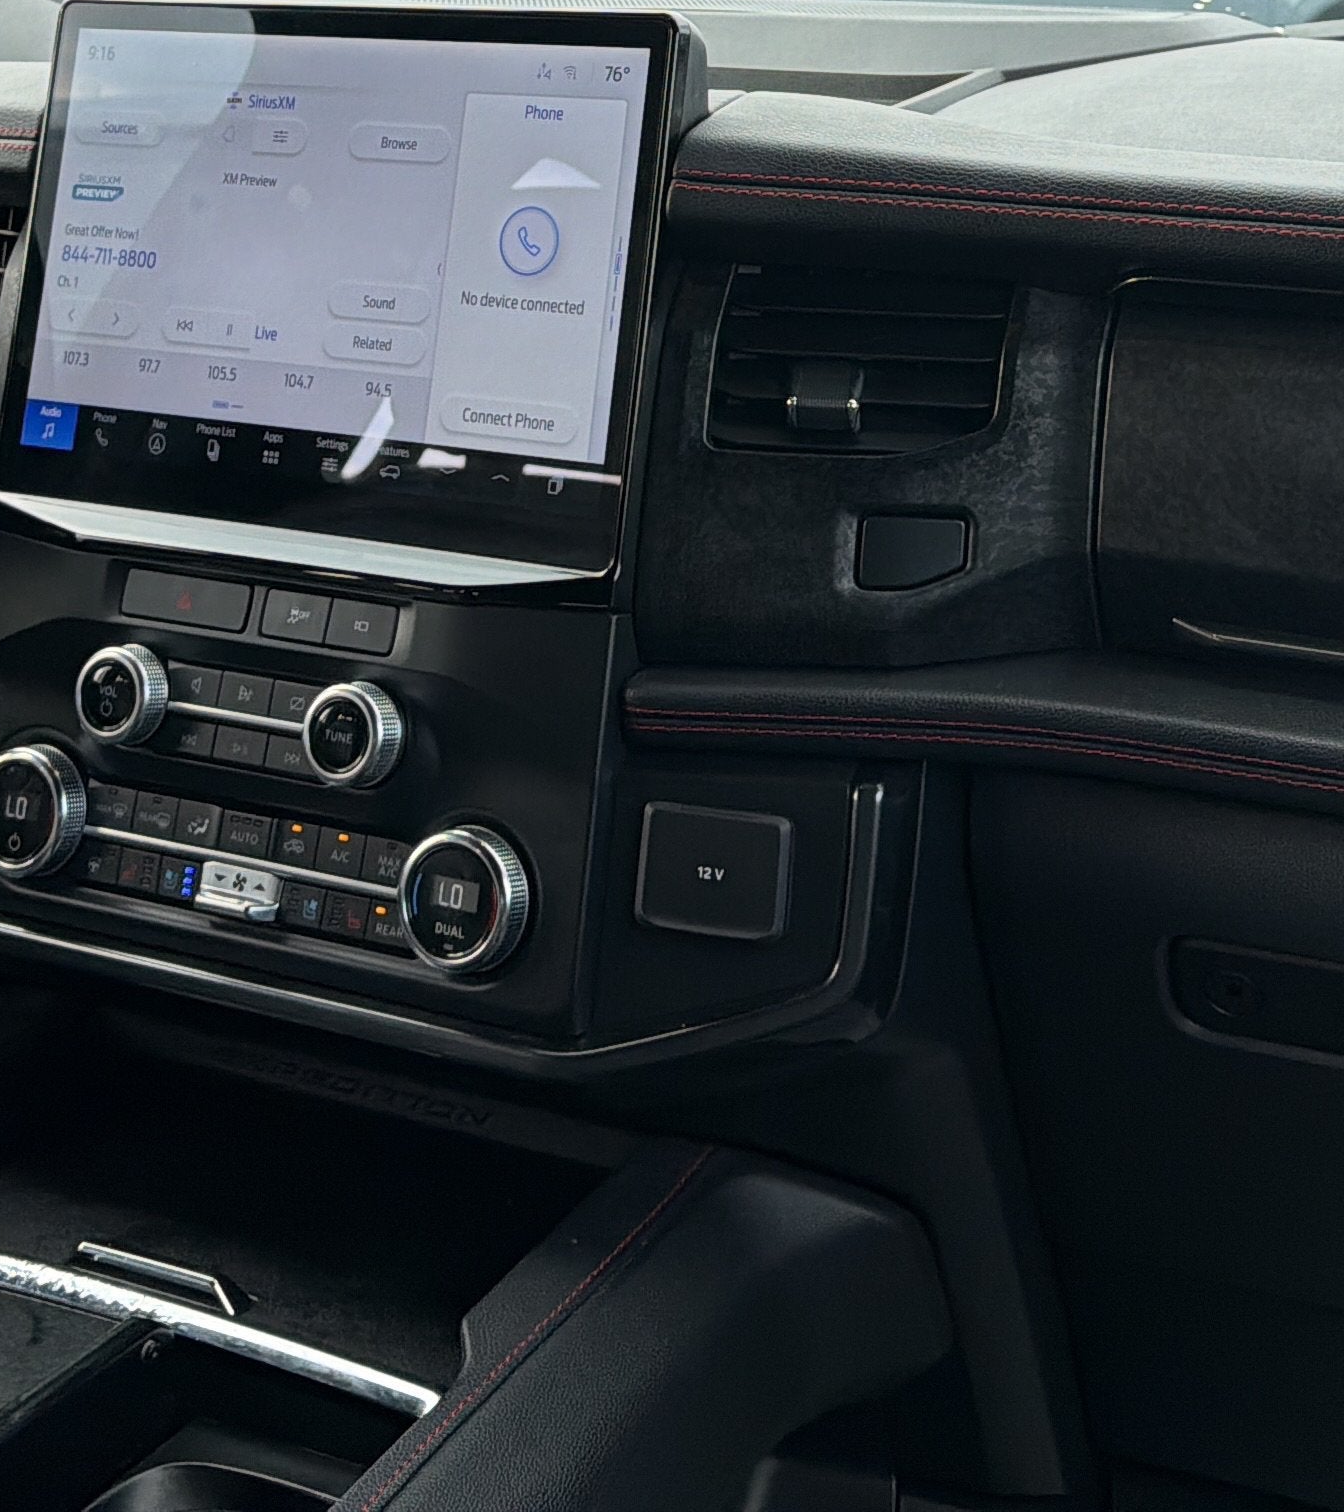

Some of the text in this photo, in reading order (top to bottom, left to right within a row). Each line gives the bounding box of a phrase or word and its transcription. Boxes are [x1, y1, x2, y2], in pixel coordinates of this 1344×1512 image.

[88, 45, 116, 61] 9:16
[605, 65, 631, 82] 76°
[248, 94, 296, 111] SiriusXM
[524, 104, 564, 121] Phone
[101, 120, 138, 136] Sources
[380, 136, 418, 151] Browse
[78, 173, 122, 185] SIRIUSXM
[222, 172, 277, 188] XM Preview
[64, 224, 140, 241] Great Offer Now!
[61, 244, 157, 269] 844-711-8800
[363, 295, 396, 310] Sound
[461, 291, 585, 316] No device connected
[255, 325, 278, 341] Live
[352, 336, 392, 352] Related
[63, 350, 89, 367] 107.3
[138, 358, 161, 374] 97.7
[207, 365, 237, 382] 105.5
[283, 373, 314, 390] 104.7
[365, 381, 392, 398] 94.5
[40, 406, 62, 418] Audio
[93, 411, 118, 425] Phone
[462, 407, 555, 432] Connect Phone
[152, 419, 168, 431] Nav
[196, 423, 237, 439] Phone List
[263, 431, 284, 445] Apps
[316, 436, 350, 453] Settings
[377, 444, 410, 458] eatures
[100, 686, 117, 699] VOL
[325, 730, 353, 746] TUNE
[6, 795, 28, 820] LO
[230, 831, 259, 845] AUTO
[330, 847, 350, 864] A/C
[378, 854, 401, 868] MAX
[697, 866, 725, 881] 12 V
[439, 882, 463, 909] LO
[375, 923, 405, 938] REAR
[435, 921, 465, 941] DUAL
